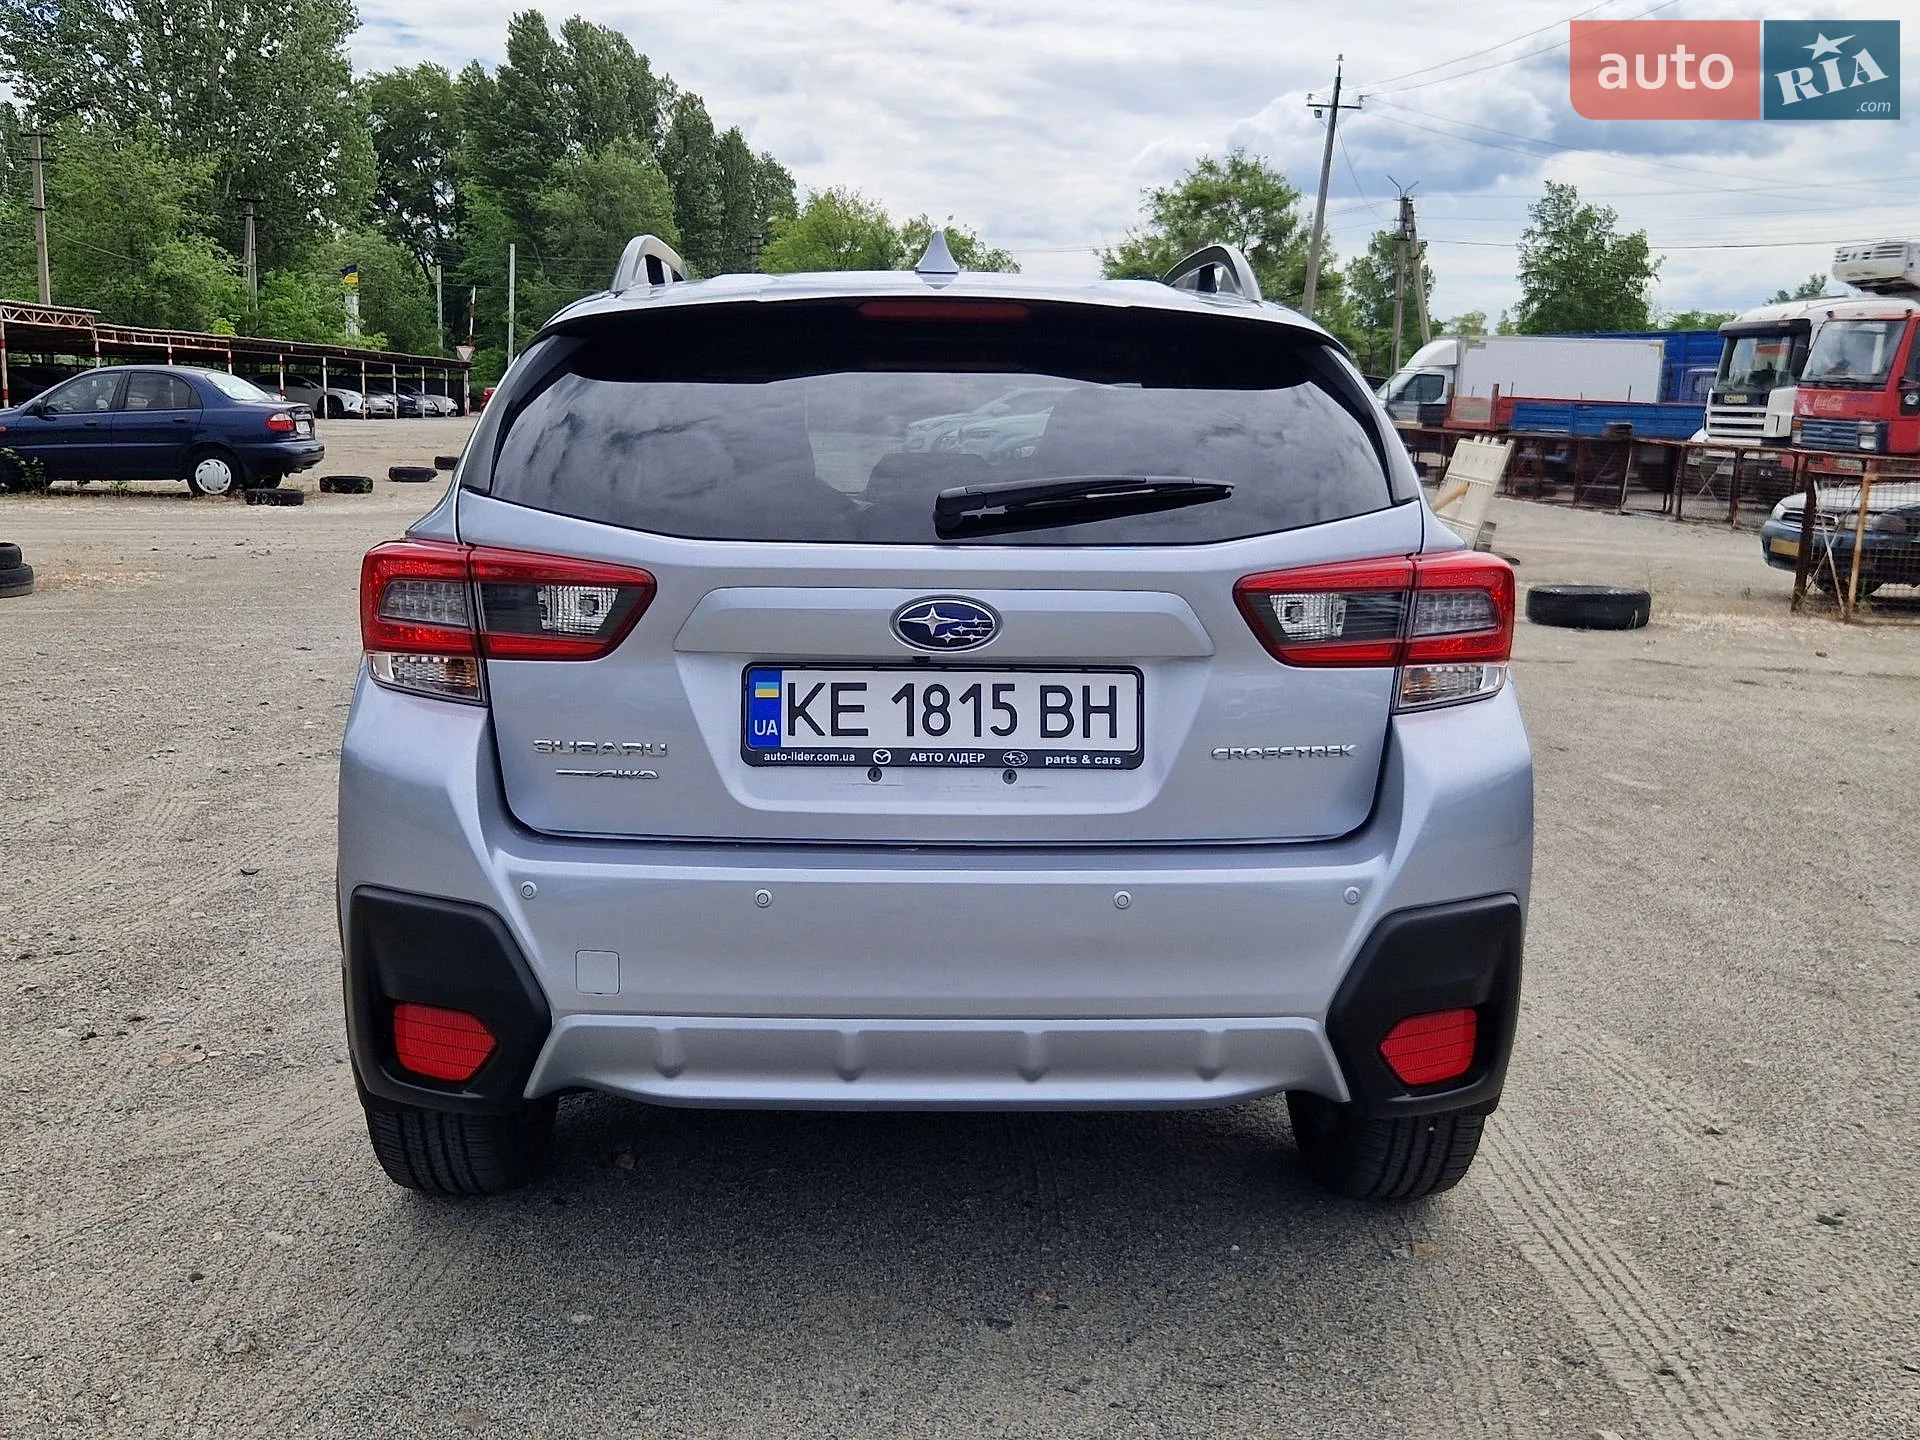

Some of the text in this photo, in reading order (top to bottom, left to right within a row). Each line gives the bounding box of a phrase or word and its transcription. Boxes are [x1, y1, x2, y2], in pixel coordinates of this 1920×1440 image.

[787, 682, 1118, 739] KE 1815 BH
[754, 719, 779, 736] UA
[533, 738, 668, 757] SUBARU
[1211, 743, 1357, 760] CROSSTREK
[763, 751, 856, 763] auto-lider.com.ua
[909, 752, 945, 763] АВТО
[1045, 754, 1122, 767] parts & cars
